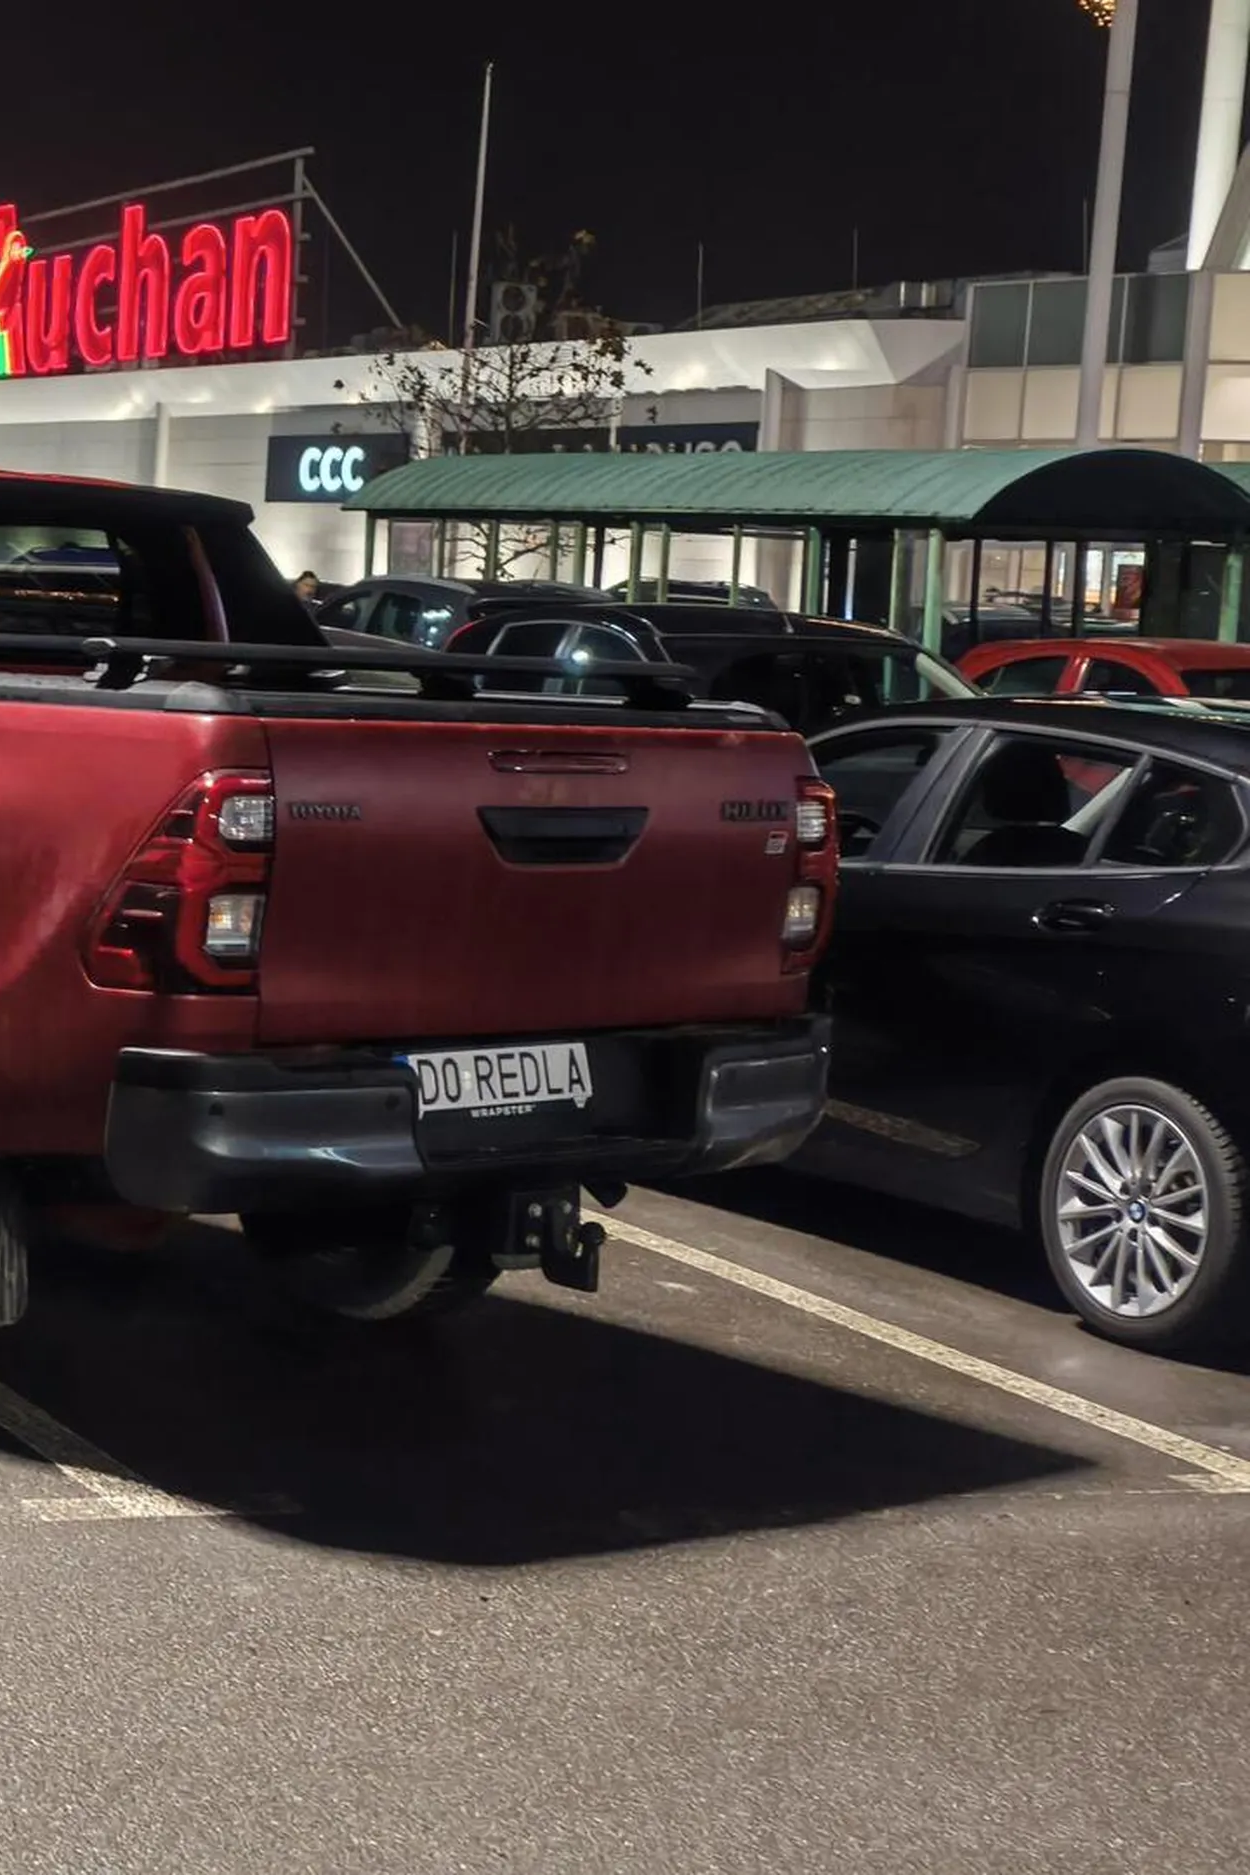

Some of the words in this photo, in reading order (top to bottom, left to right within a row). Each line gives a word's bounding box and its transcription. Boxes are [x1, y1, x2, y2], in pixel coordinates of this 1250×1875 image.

[298, 445, 365, 493] CCC
[474, 1048, 587, 1101] REDLA
[469, 1104, 534, 1119] WRAPSTER
